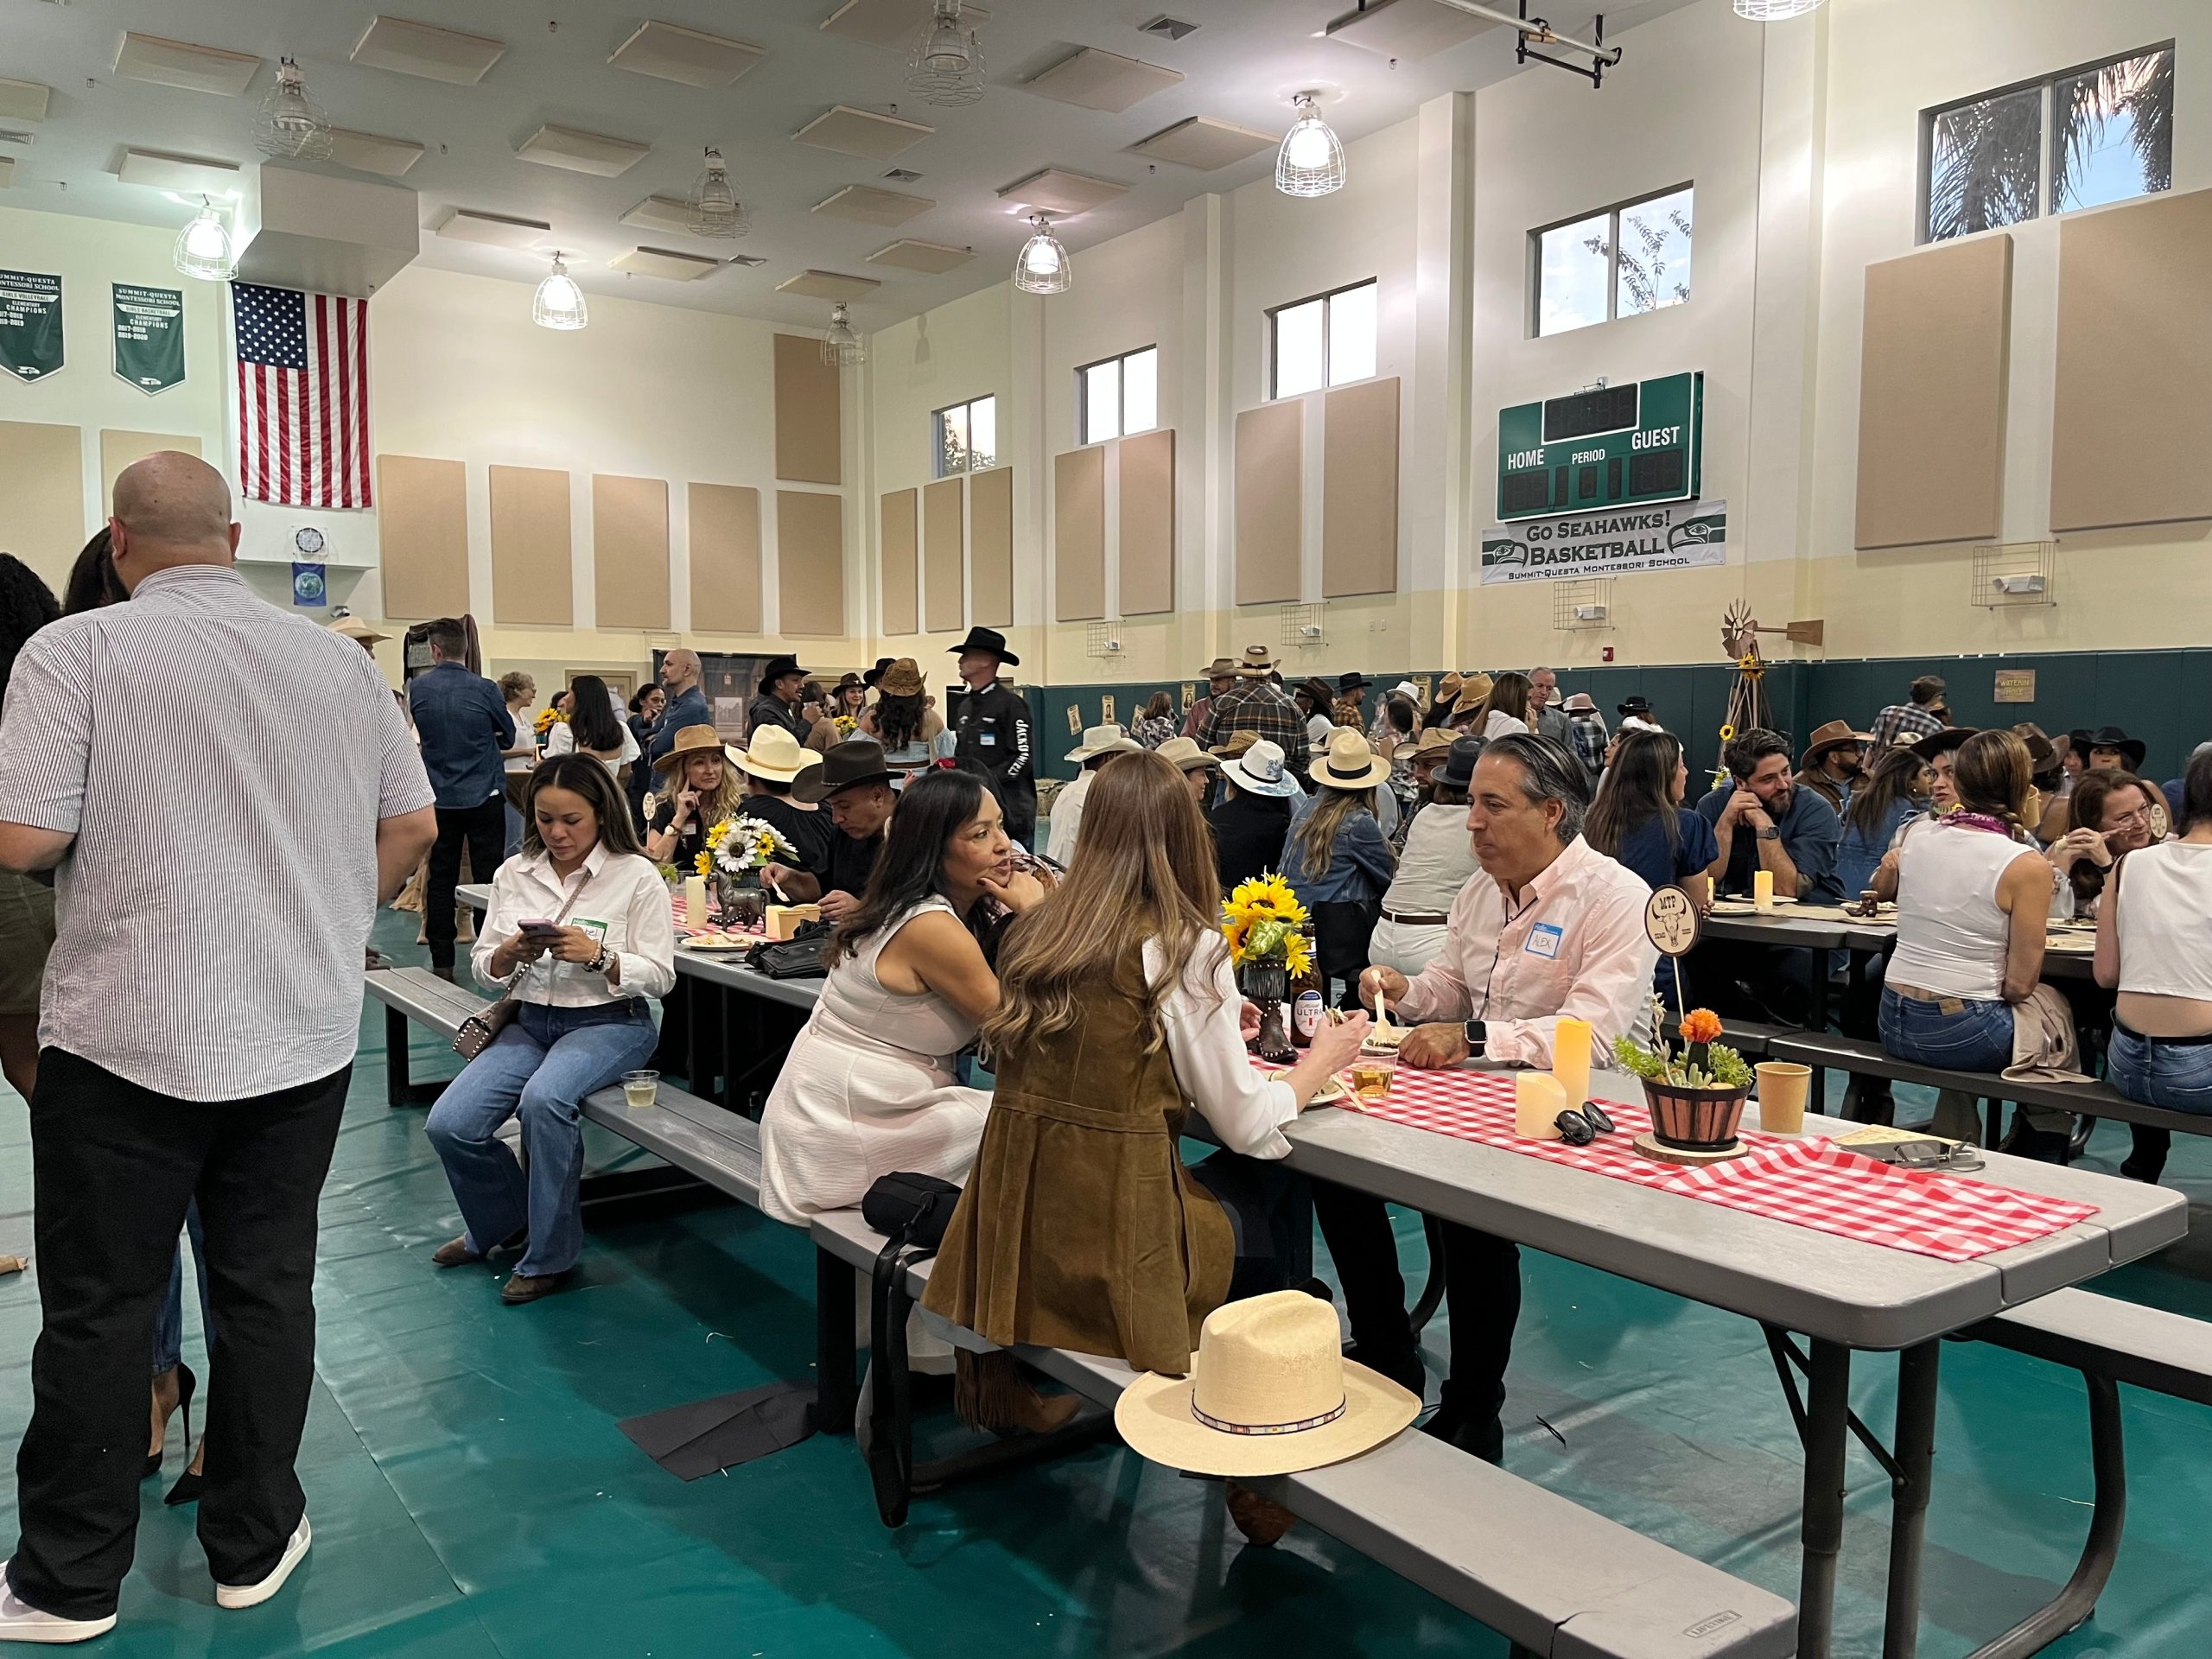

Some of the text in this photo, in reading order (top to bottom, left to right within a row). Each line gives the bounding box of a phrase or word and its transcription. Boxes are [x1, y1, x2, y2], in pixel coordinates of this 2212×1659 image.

[116, 294, 181, 307] MONTESSORI SCHOOL
[118, 289, 176, 300] SUMMIT-QUESTA
[6, 304, 47, 315] CHAMPIONS
[130, 318, 168, 329] CHAMPIONS
[1631, 426, 1681, 450] GUEST
[1508, 448, 1605, 470] HOME PERIOD
[1526, 510, 1671, 542] GO SEAHAWKS!
[1530, 537, 1665, 566] BASKETBALL
[1508, 556, 1691, 581] SUMMIT-QUESTA MONTESSORI SCHOOL
[1659, 894, 1676, 911] MTP
[1296, 1007, 1323, 1016] ULTRA
